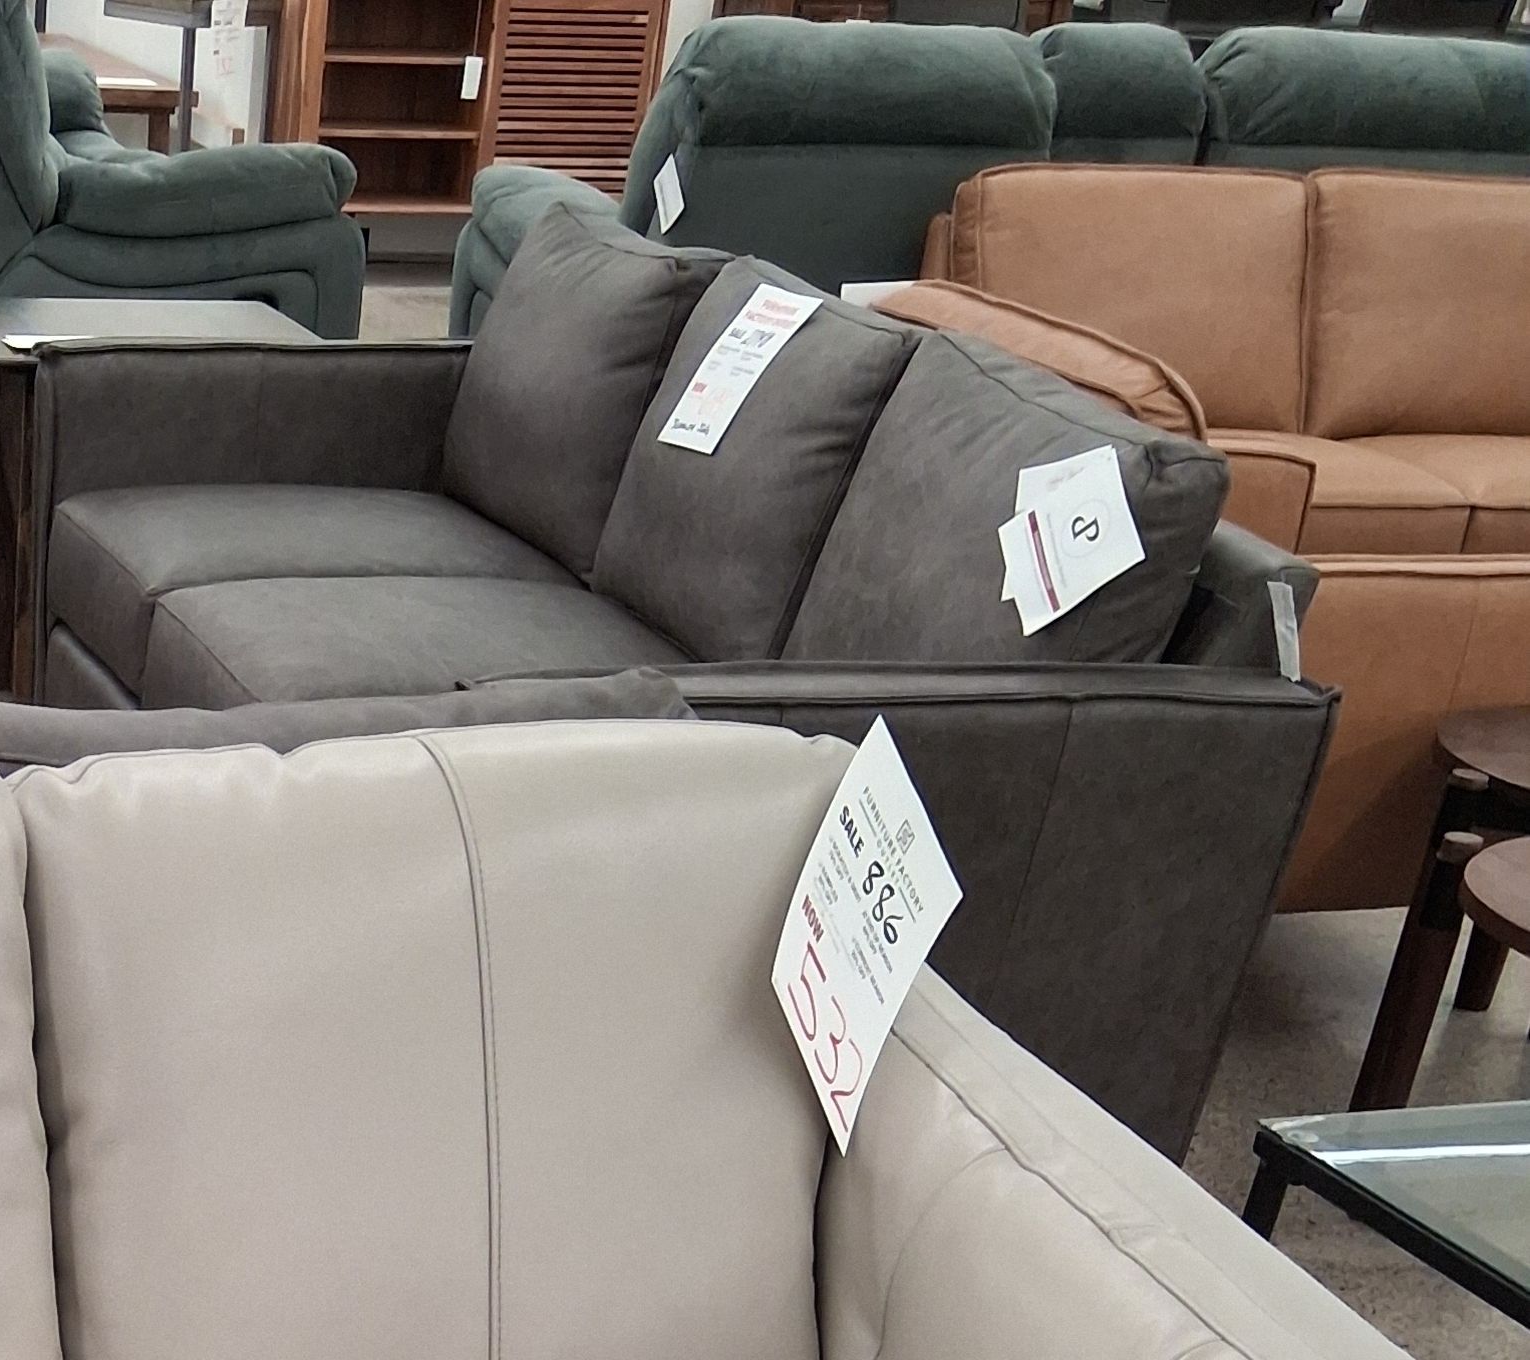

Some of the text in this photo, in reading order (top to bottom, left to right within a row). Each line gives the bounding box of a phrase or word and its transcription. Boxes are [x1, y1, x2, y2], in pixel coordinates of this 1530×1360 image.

[840, 806, 864, 858] SALE
[863, 861, 903, 944] 886
[863, 786, 923, 912] FURNITURE FACTORY
[802, 894, 824, 943] NOW
[788, 941, 863, 1132] 532
